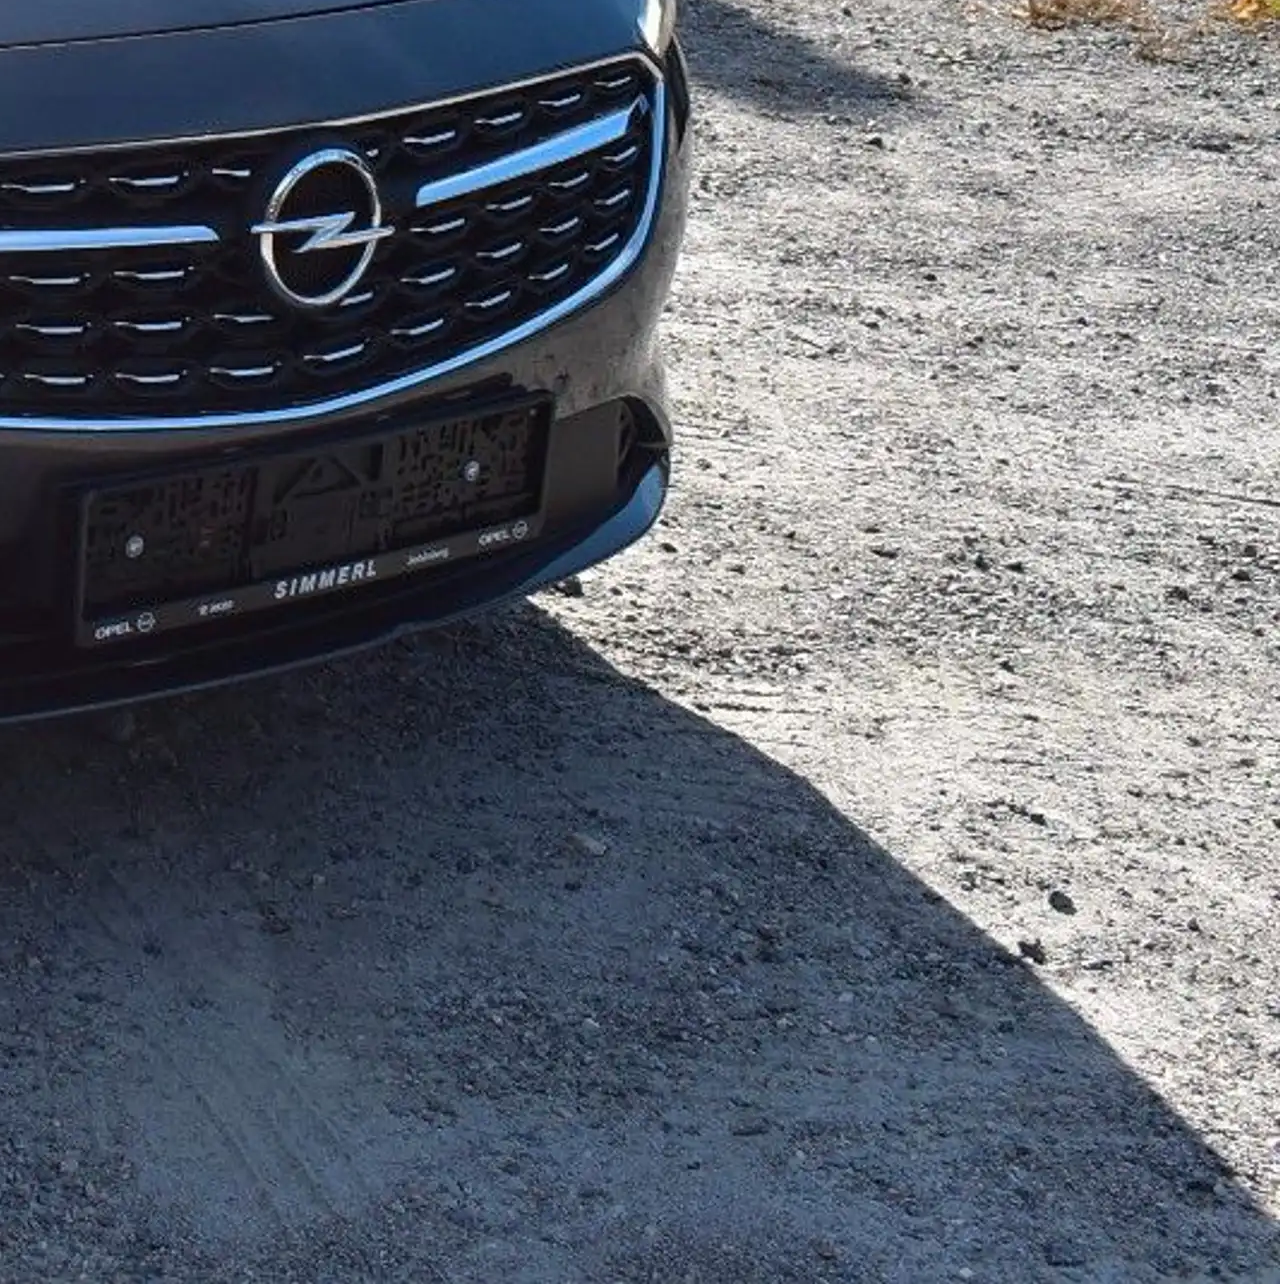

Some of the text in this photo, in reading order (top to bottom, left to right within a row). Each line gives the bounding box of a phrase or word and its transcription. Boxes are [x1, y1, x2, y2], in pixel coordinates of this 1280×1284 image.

[94, 528, 510, 640] OPEL SIMMERL OPEL
